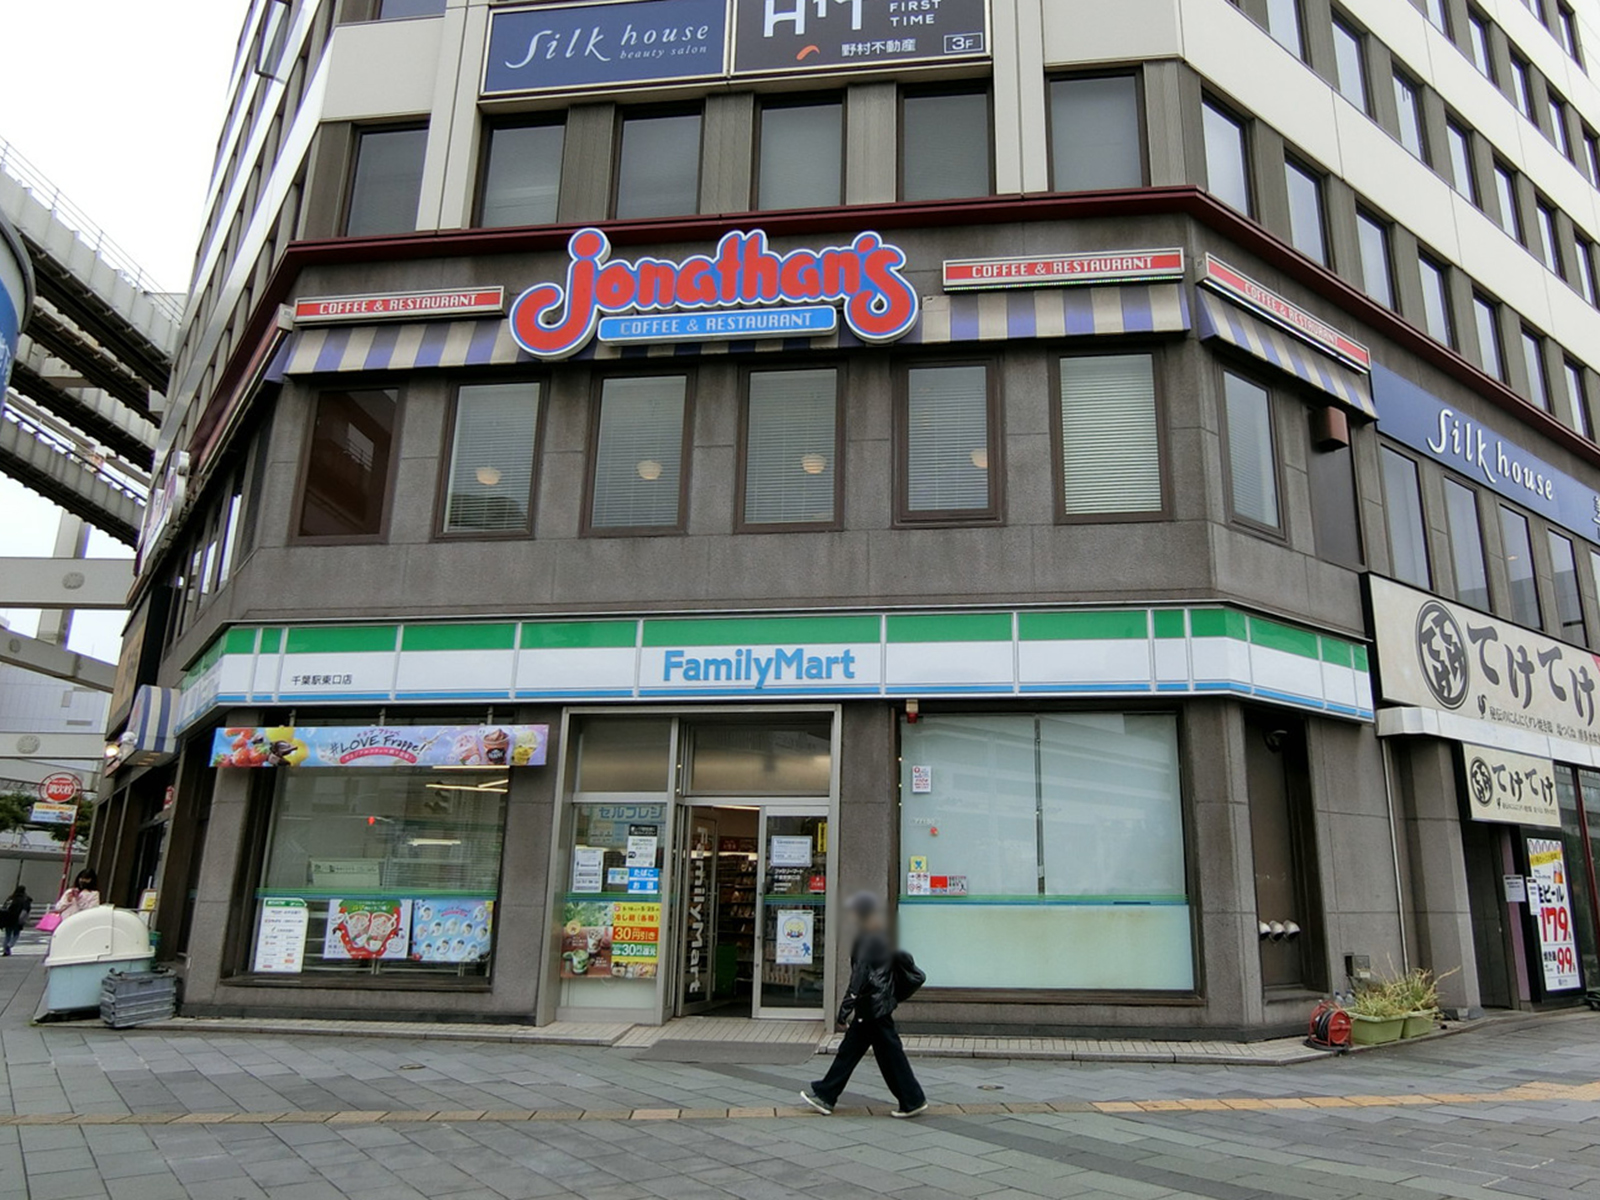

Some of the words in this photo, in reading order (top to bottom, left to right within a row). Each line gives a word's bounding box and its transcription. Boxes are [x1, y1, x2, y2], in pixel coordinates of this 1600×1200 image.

[890, 0, 942, 13] FIRST
[890, 14, 936, 27] TIME
[505, 26, 611, 69] Silk
[620, 24, 709, 46] house
[620, 49, 665, 60] beauty
[670, 45, 708, 57] salon
[841, 38, 917, 57] 野村不動産
[951, 36, 974, 50] 3F
[972, 262, 1029, 279] COFFEE
[1034, 263, 1047, 276] &
[1053, 256, 1153, 274] RESTAURANT
[319, 300, 368, 315] COFFEE
[373, 299, 384, 312] &
[389, 294, 478, 311] RESTAURANT
[1244, 282, 1278, 310] COFFEE
[1288, 307, 1339, 347] RESTAURANT
[620, 319, 680, 335] COFFEE
[686, 319, 699, 332] &
[706, 312, 812, 331] RESTAURANT
[1427, 408, 1497, 484] Silk
[1497, 441, 1553, 501] house
[291, 674, 353, 686] 千葉駅東口店
[663, 648, 855, 689] FamilyMart
[1466, 621, 1595, 726] てけてけ
[330, 735, 380, 756] #LOVE
[383, 734, 427, 756] Frappe!
[1491, 764, 1553, 806] てけてけ
[689, 827, 708, 993] FamilyMart
[1541, 906, 1569, 942] 179
[1557, 946, 1573, 975] 99
